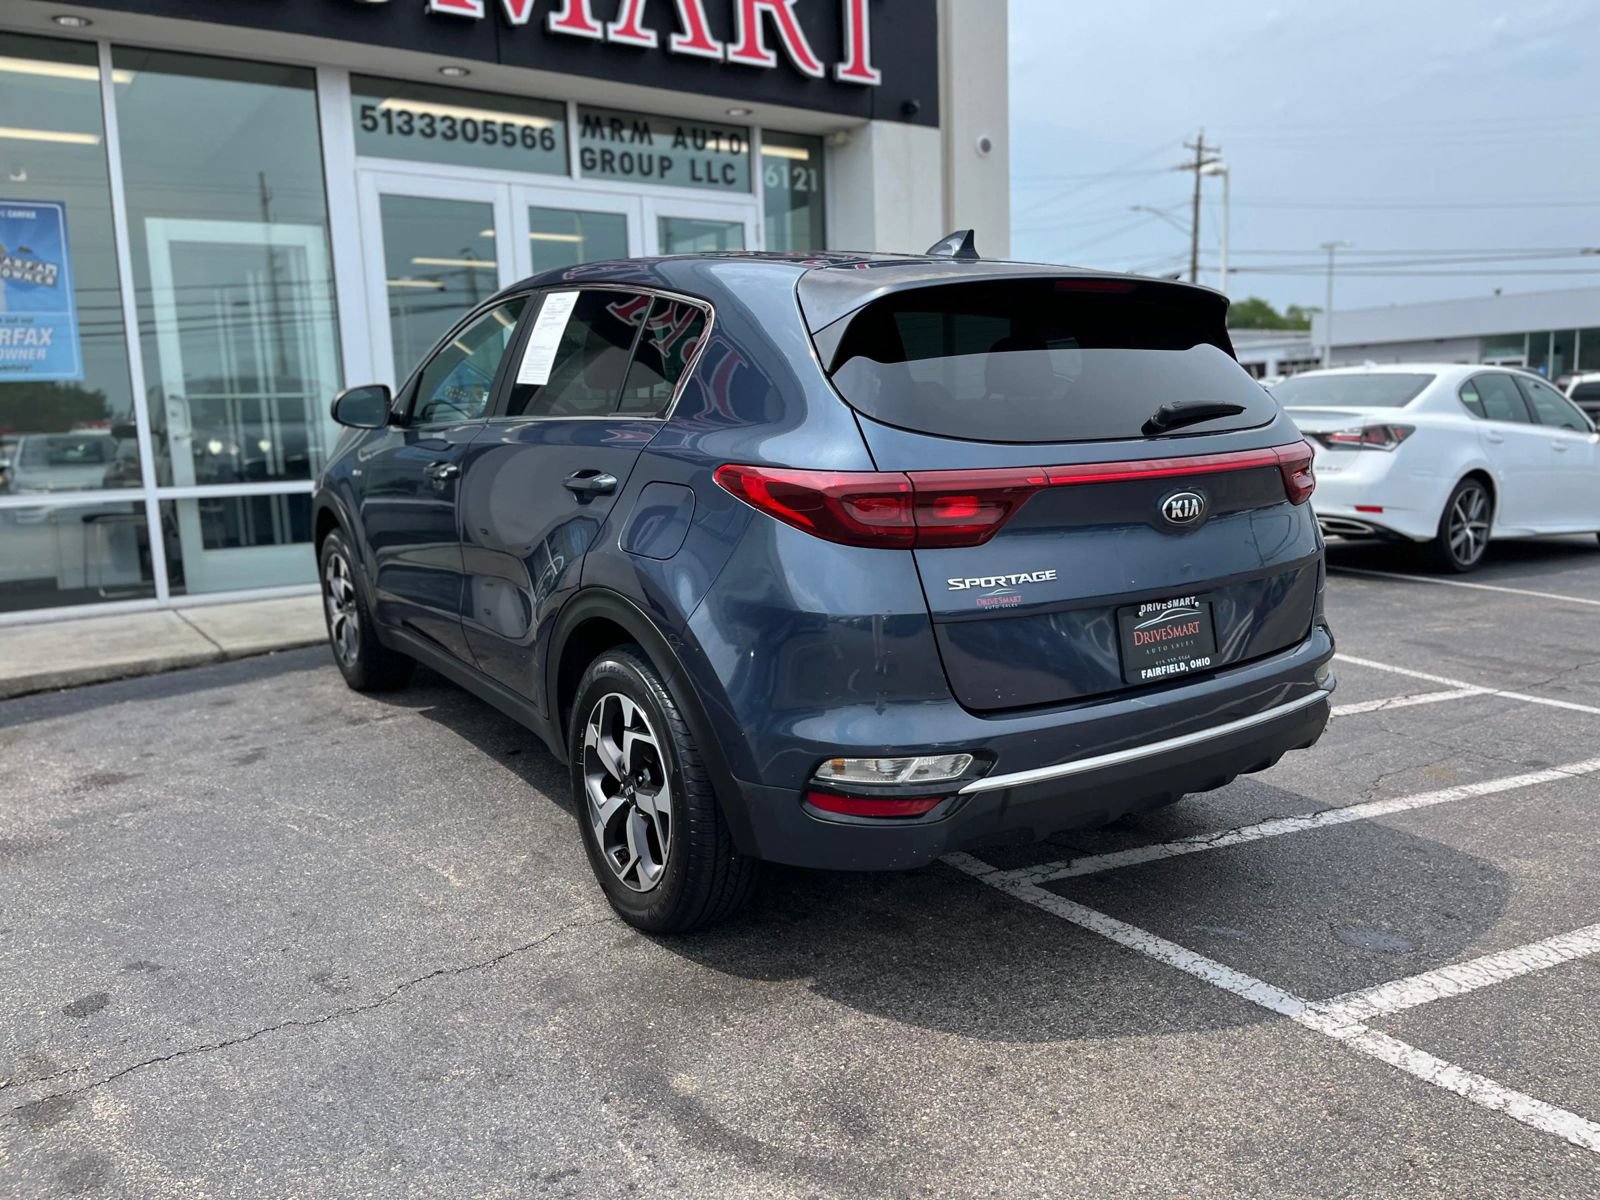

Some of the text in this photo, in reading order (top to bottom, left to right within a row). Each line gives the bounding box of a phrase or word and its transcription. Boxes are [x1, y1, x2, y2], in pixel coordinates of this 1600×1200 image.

[360, 104, 556, 151] 5133305566
[580, 114, 743, 155] MRM AUTO
[579, 147, 737, 185] GROUP LLC
[764, 164, 817, 191] 6121
[1171, 499, 1199, 518] KIA
[947, 569, 1057, 590] SPORTAGE
[1140, 596, 1196, 614] DRIVESMART
[1141, 662, 1189, 680] FAIRFIELD,
[1190, 657, 1211, 669] OHIO
